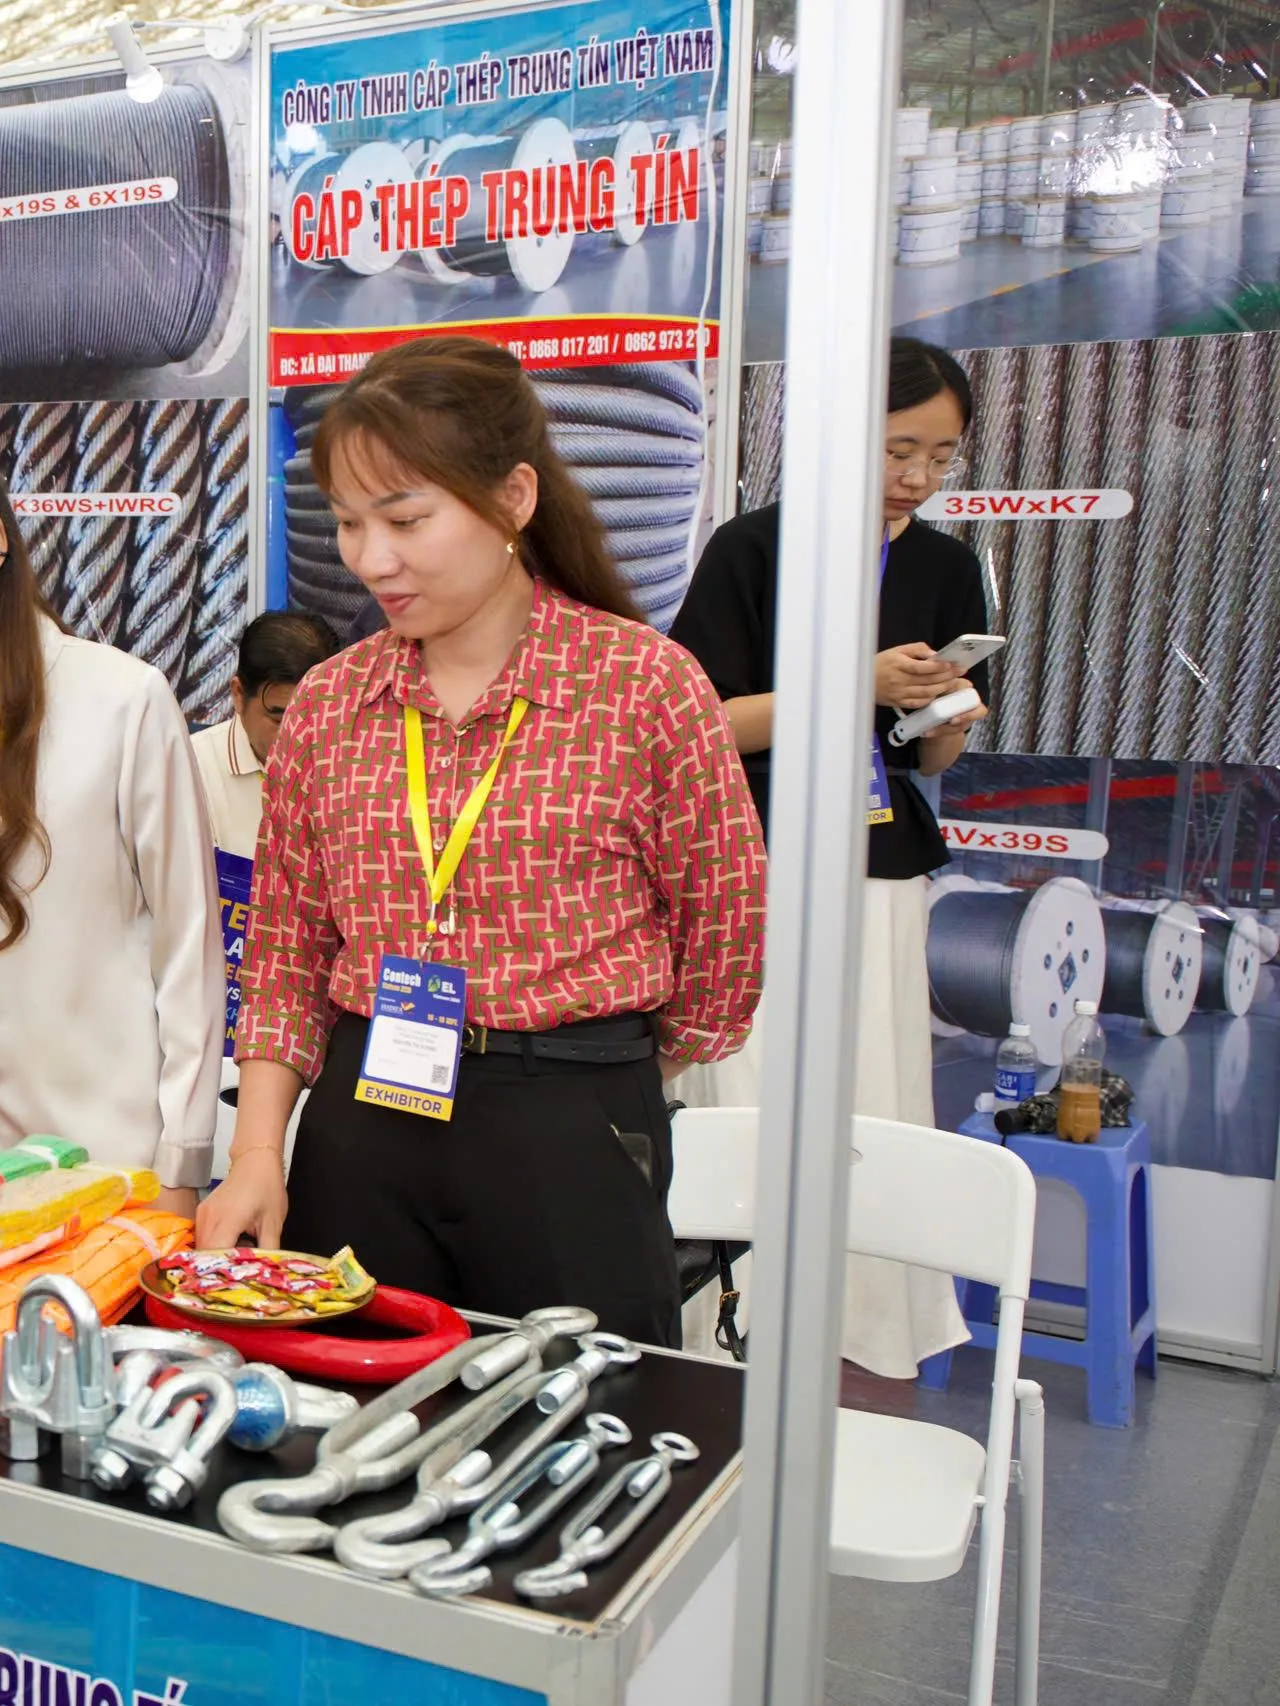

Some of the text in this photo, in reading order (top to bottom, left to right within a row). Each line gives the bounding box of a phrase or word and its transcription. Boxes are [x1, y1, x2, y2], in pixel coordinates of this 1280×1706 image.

[283, 27, 714, 127] CÔNG TY TNHH CÁP THÉP TRUNG TÍN VIỆT NAM
[64, 194, 80, 210] &
[88, 184, 163, 207] 6X19S
[291, 134, 701, 263] CÁP THÉP TRUNG TÍN
[338, 352, 374, 373] THAN
[529, 338, 559, 360] 0868
[562, 336, 585, 357] 817
[587, 334, 609, 355] 201
[624, 331, 656, 353] 0862
[659, 328, 683, 350] 973
[13, 497, 174, 514] K36WS+IWRC
[944, 494, 1102, 517] 35WxK7
[364, 1086, 442, 1114] EXHIBITOR
